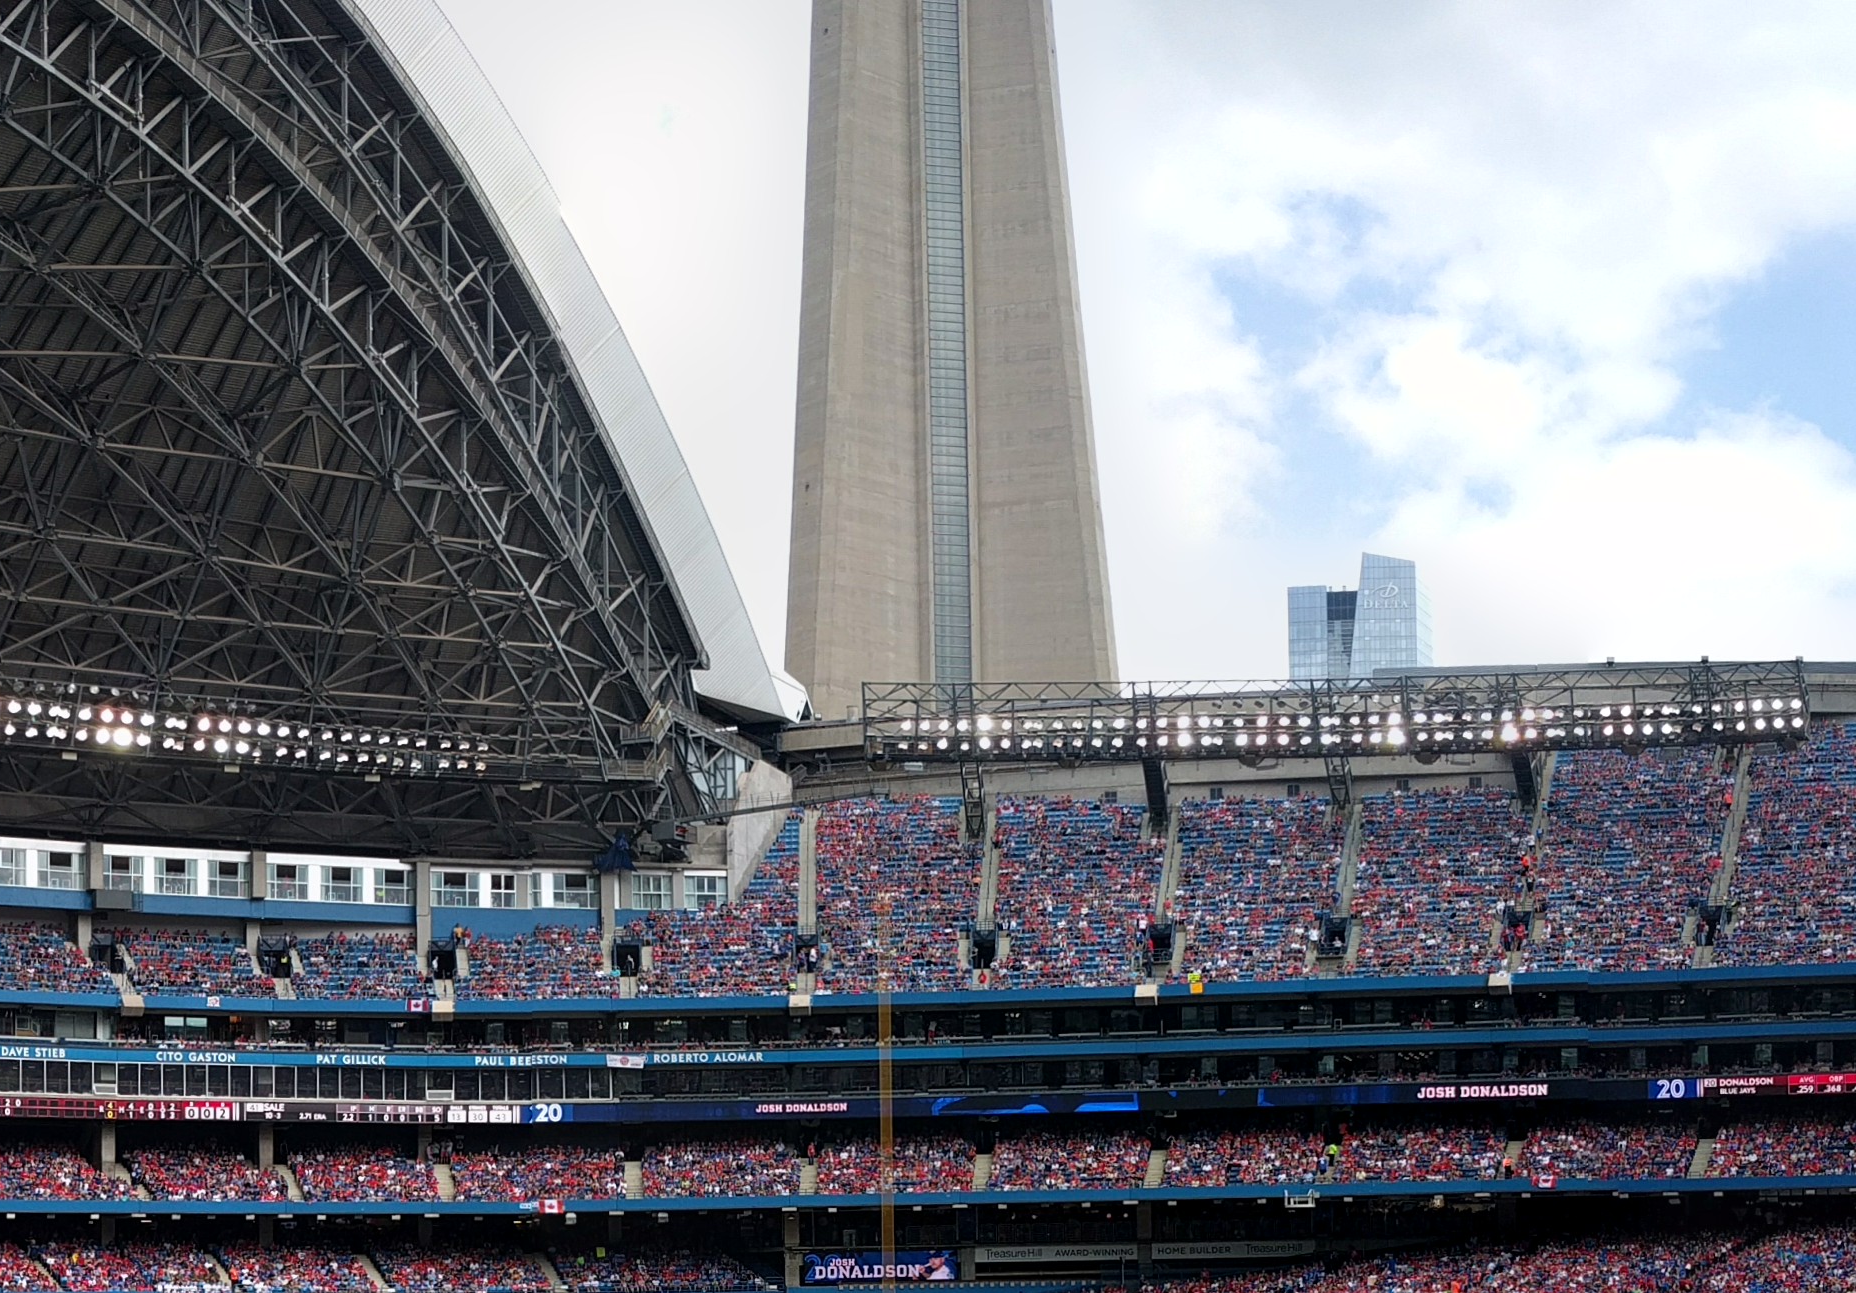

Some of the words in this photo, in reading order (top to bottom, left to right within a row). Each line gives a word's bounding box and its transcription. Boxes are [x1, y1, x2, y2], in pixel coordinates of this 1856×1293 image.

[1, 1046, 29, 1057] DAVE
[35, 1048, 66, 1058] STIEB
[156, 1051, 183, 1062] CITO
[190, 1053, 236, 1063] GASTON
[654, 1053, 708, 1063] ROBERTO
[714, 1052, 764, 1062] ALOMAR
[317, 1055, 336, 1064] PAT
[342, 1055, 386, 1065] GILLICK
[475, 1057, 503, 1065] PAUL
[1720, 1078, 1773, 1086] DONALDSON
[1417, 1087, 1455, 1098] JOSH
[1460, 1084, 1548, 1097] DONALDSON
[1657, 1079, 1685, 1098] 20
[263, 1104, 284, 1112] SALE
[536, 1104, 562, 1122] 20
[756, 1104, 782, 1113] JOSH
[786, 1102, 847, 1112] DONALDSON
[1055, 1249, 1134, 1257] AWARD-WINNING
[1158, 1247, 1189, 1255] HOME
[1193, 1246, 1231, 1254] BUILDER
[830, 1258, 855, 1267] JOSH
[815, 1265, 920, 1279] DONALDSON
